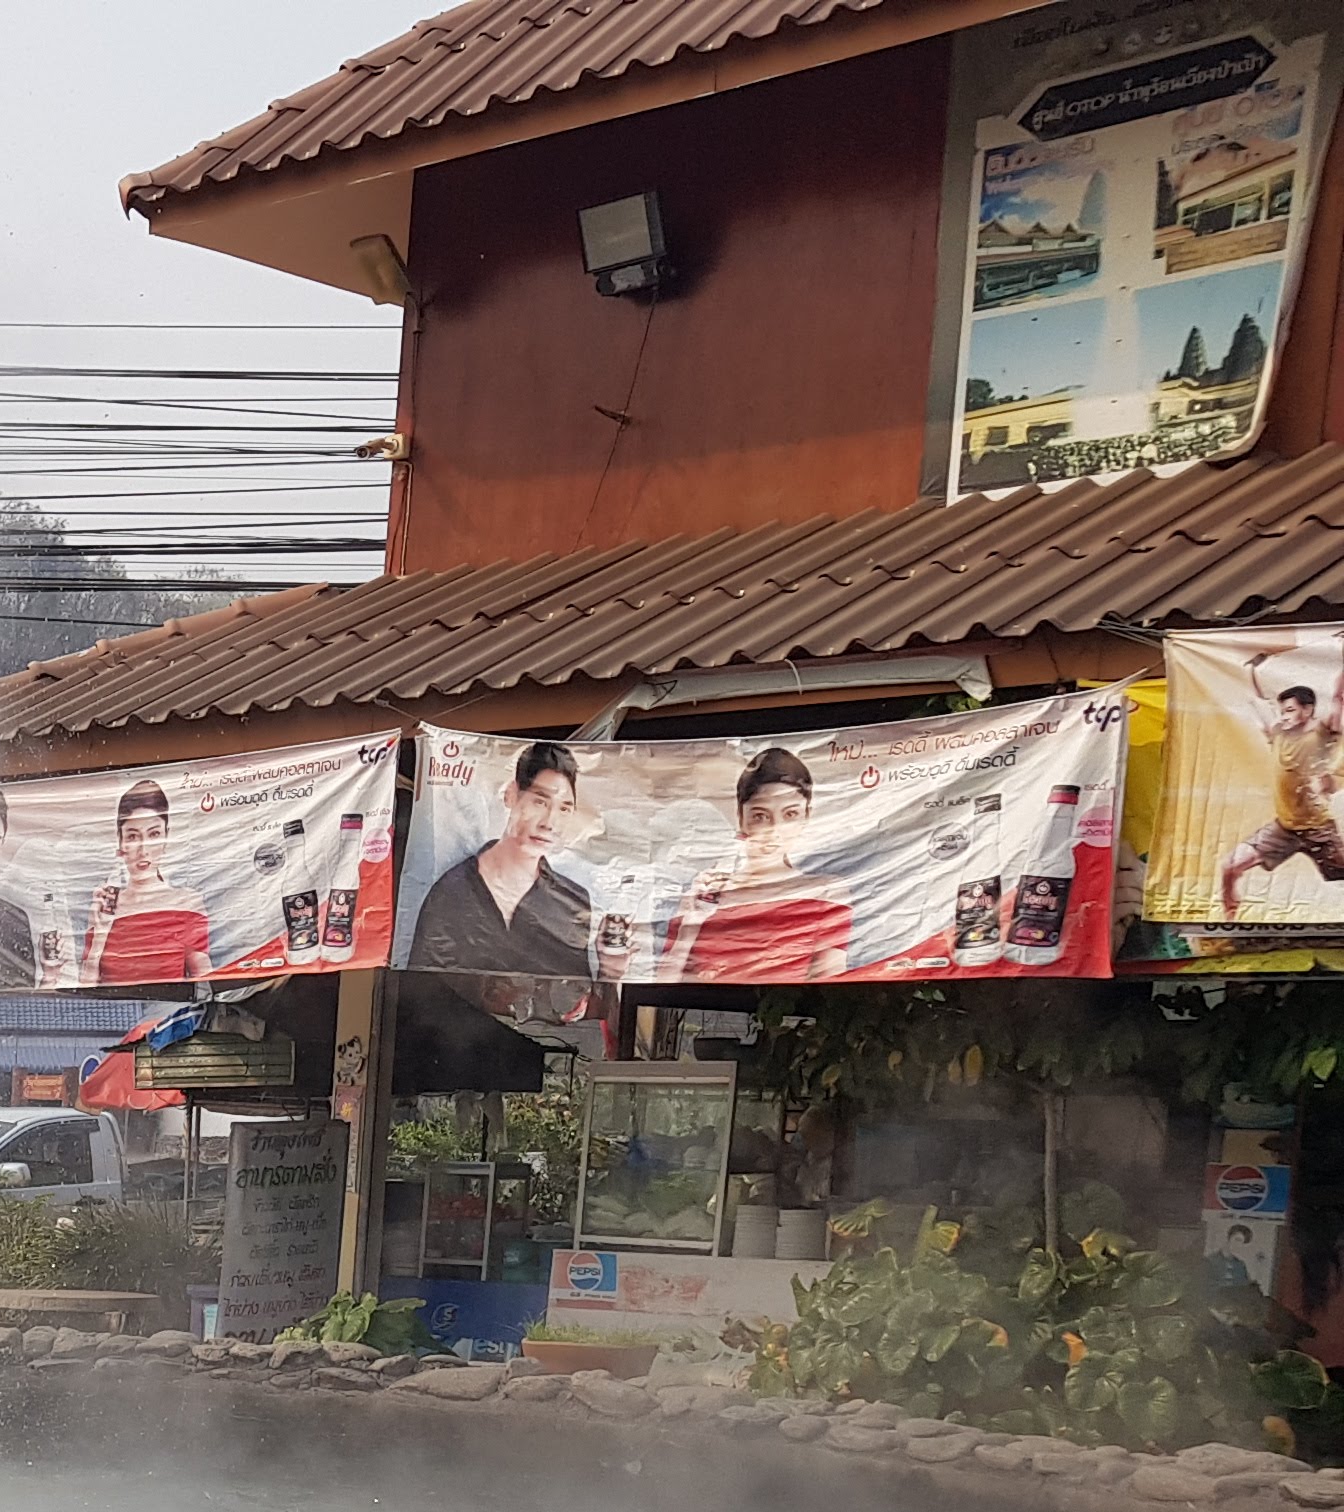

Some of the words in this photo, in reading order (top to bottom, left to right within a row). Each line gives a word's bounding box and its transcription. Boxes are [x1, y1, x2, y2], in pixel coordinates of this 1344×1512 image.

[1083, 701, 1121, 732] tcp
[428, 756, 474, 787] Ready
[568, 1265, 601, 1277] PEPSI
